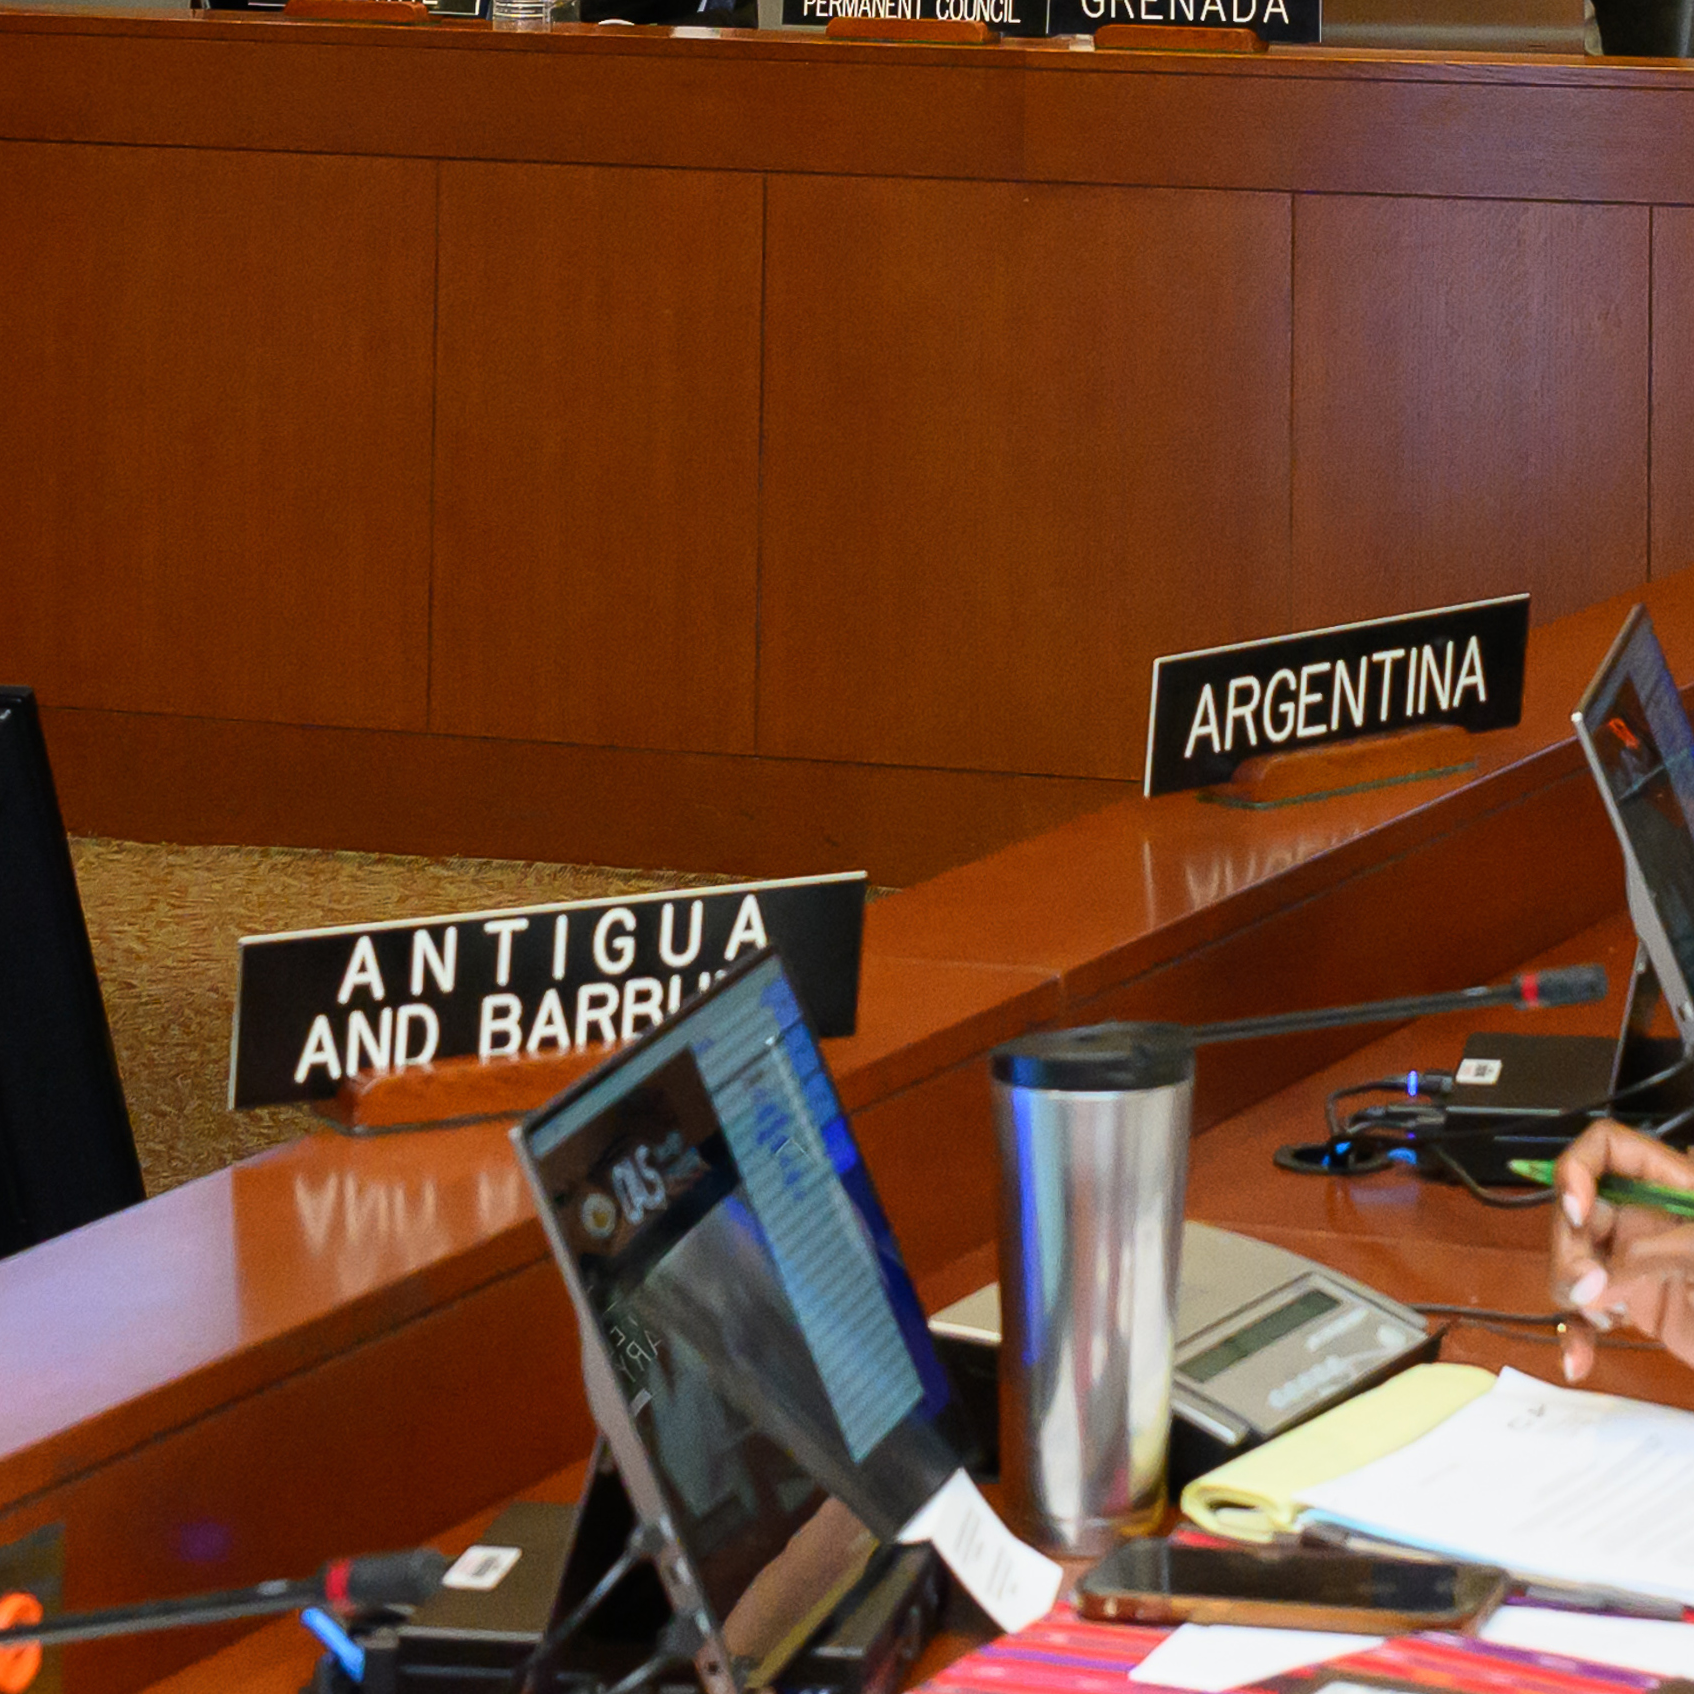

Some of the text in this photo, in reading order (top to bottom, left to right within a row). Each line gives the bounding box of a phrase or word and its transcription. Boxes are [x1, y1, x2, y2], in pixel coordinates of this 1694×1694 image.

[1184, 634, 1488, 759] ARGENTINA
[337, 893, 768, 1005] ANTIGUA
[294, 969, 726, 1084] AND BARB
